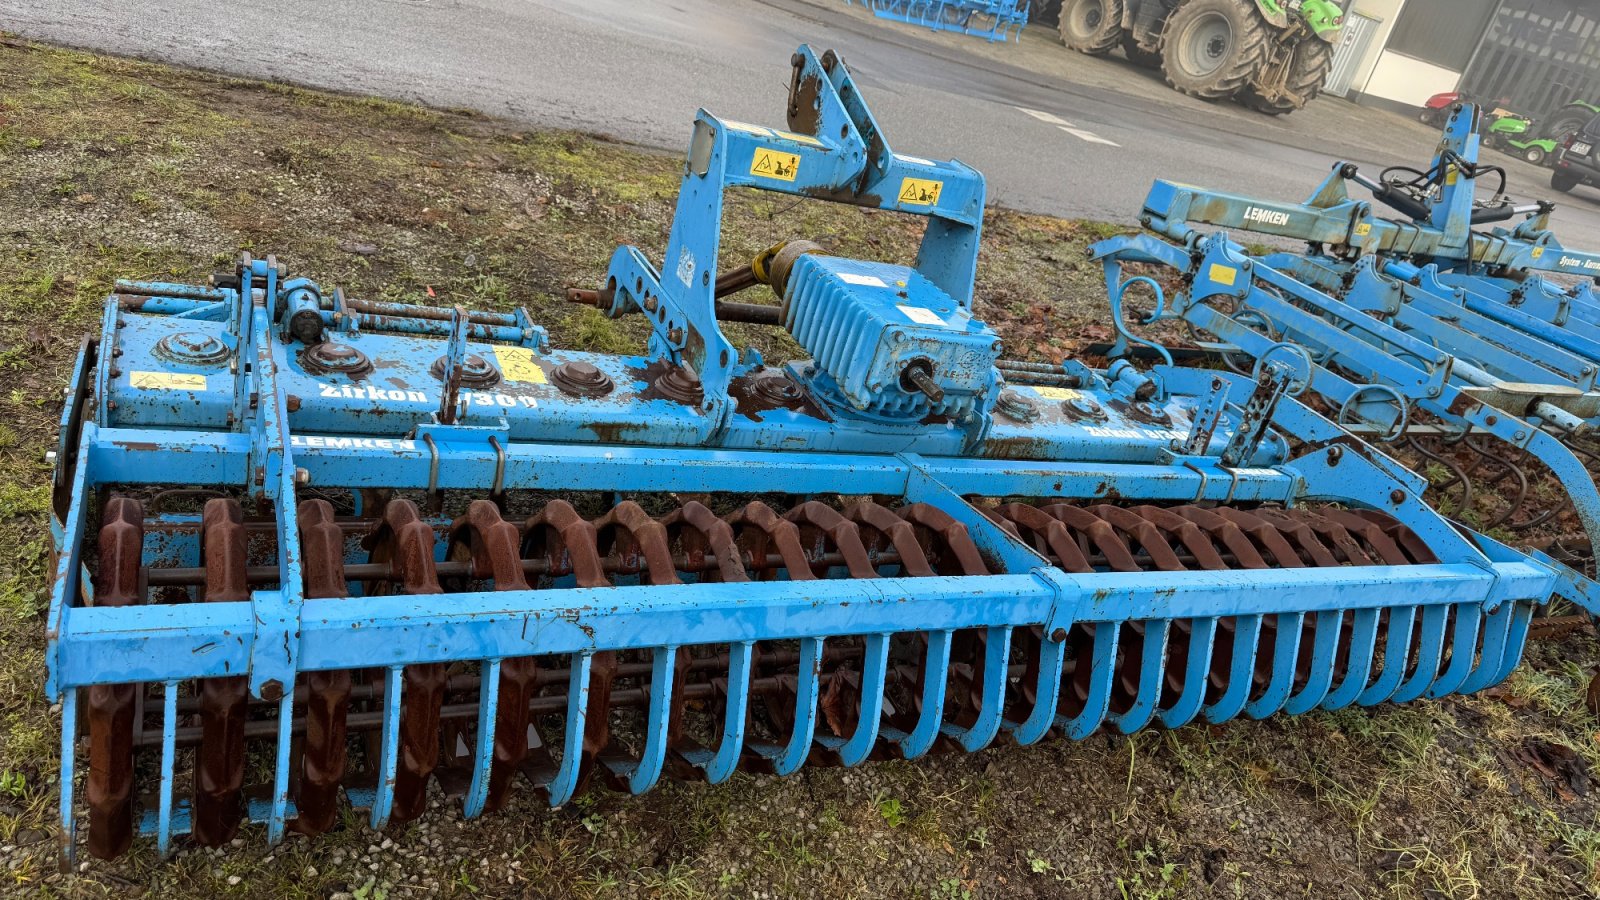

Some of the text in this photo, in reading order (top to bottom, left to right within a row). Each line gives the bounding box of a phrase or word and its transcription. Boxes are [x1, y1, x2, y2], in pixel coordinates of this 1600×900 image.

[1243, 206, 1290, 226] LEMKEN
[318, 382, 539, 409] Zirkon /300
[290, 435, 417, 451] LEMKEN
